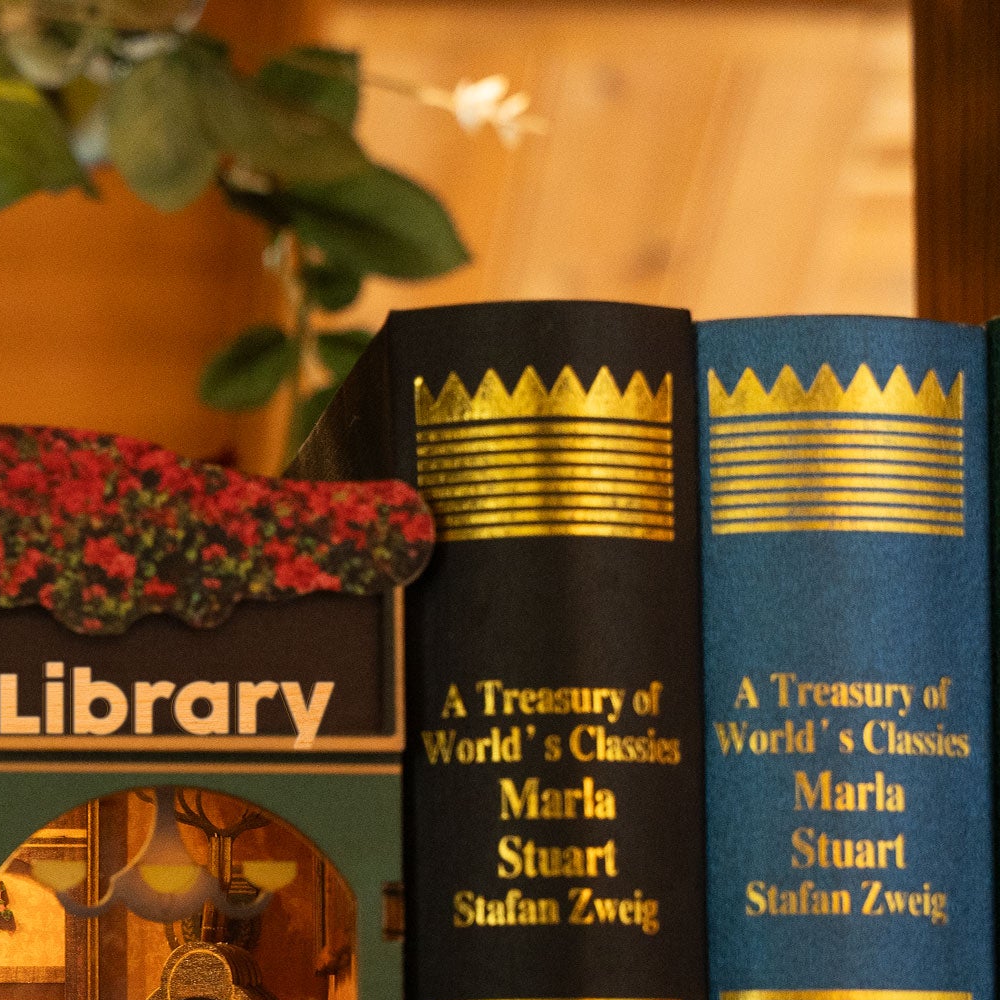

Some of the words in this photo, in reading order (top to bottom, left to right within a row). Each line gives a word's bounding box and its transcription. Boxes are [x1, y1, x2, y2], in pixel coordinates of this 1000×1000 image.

[441, 683, 467, 719] A
[476, 679, 625, 724] Treasury
[632, 680, 663, 716] of
[733, 675, 760, 709] A
[770, 672, 915, 718] Treasury
[922, 676, 952, 711] of
[569, 724, 681, 765] Classics
[862, 718, 971, 758] Classics
[499, 776, 617, 821] Marla
[794, 770, 906, 813] Marla
[497, 834, 618, 879] Stuart
[790, 826, 907, 869] Stuart
[453, 887, 560, 928] Stafan
[568, 887, 660, 936] Zweig
[745, 879, 851, 917] Stafan
[860, 880, 949, 926] Zweig
